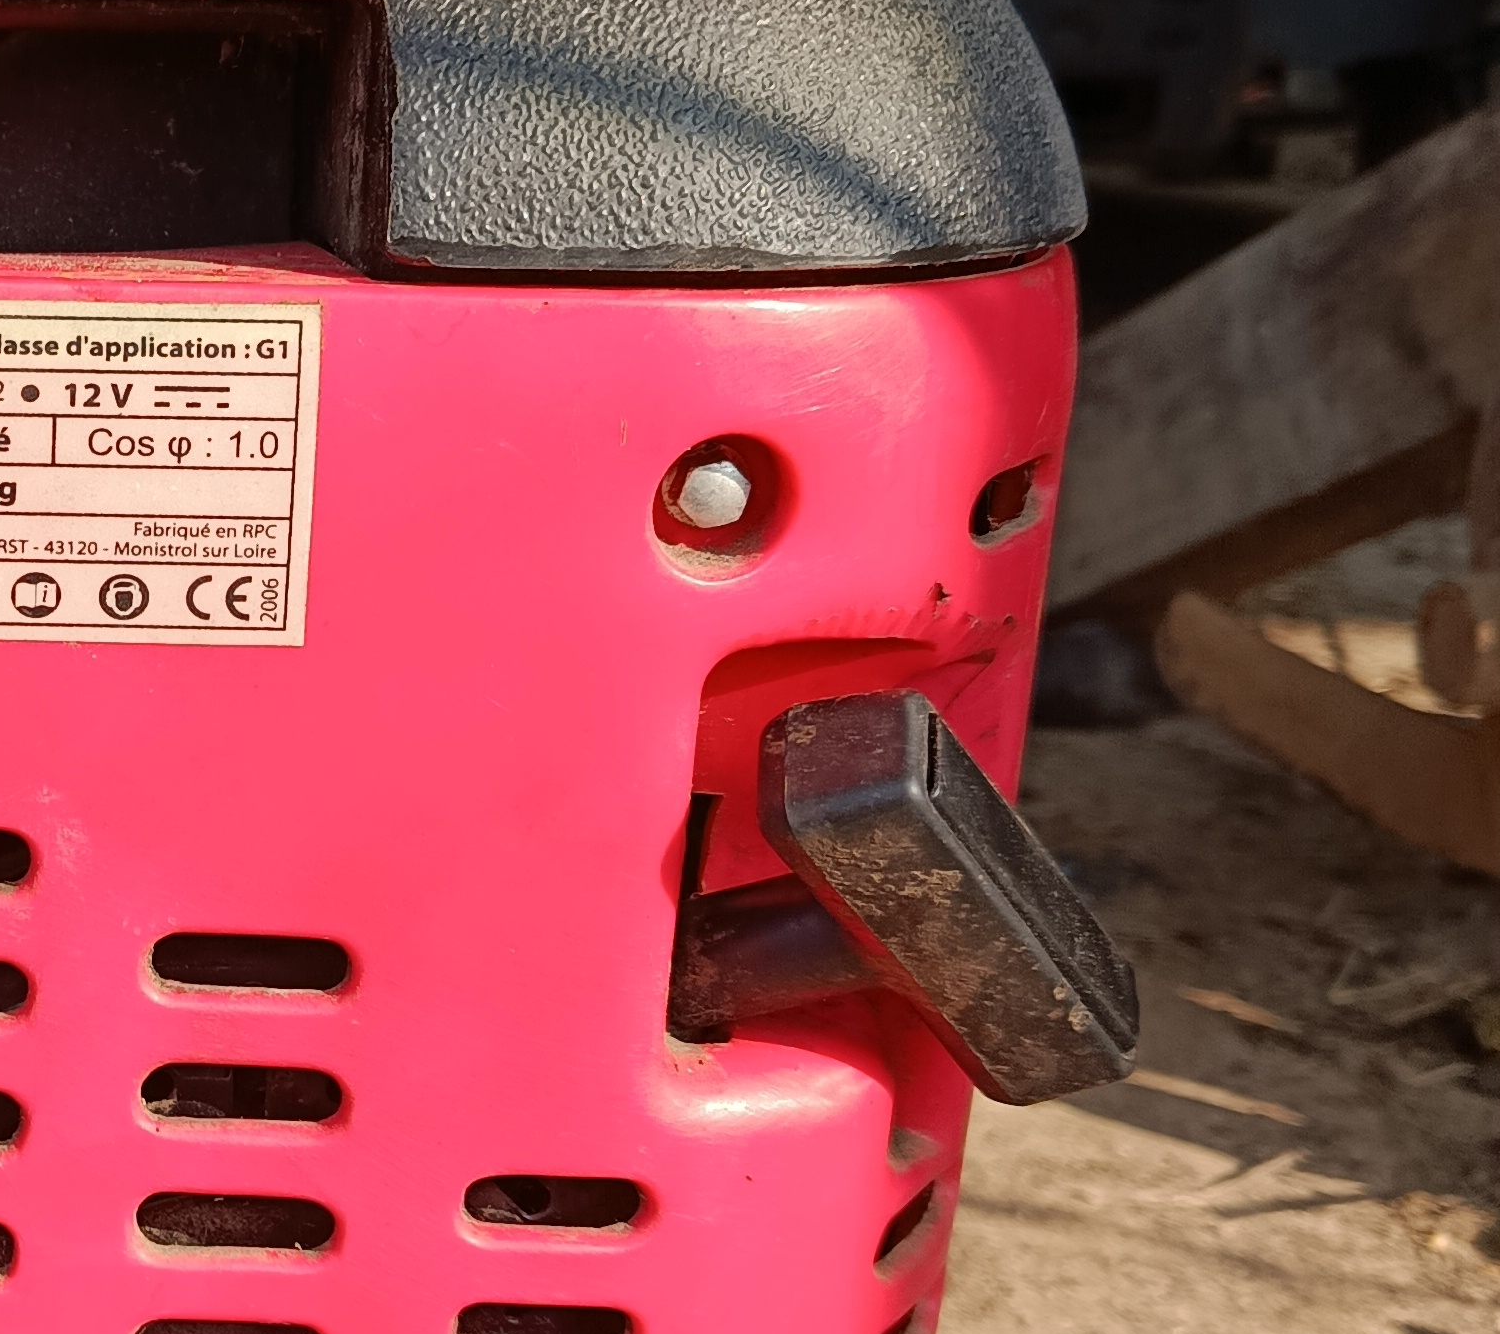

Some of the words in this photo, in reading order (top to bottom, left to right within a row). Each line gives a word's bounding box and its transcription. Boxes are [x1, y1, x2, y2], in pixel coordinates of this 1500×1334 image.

[66, 335, 235, 362] d'application
[256, 339, 288, 359] G1
[65, 383, 100, 407] 12
[111, 383, 133, 408] V
[88, 428, 154, 456] Cos
[230, 431, 278, 458] 1.0
[134, 522, 210, 541] Fabriqué
[216, 527, 236, 538] en
[243, 524, 277, 539] RPC
[44, 541, 97, 555] 43120
[114, 541, 197, 557] Monistrol
[203, 547, 229, 557] sur
[235, 544, 276, 558] Loire
[260, 578, 279, 622] 2006
